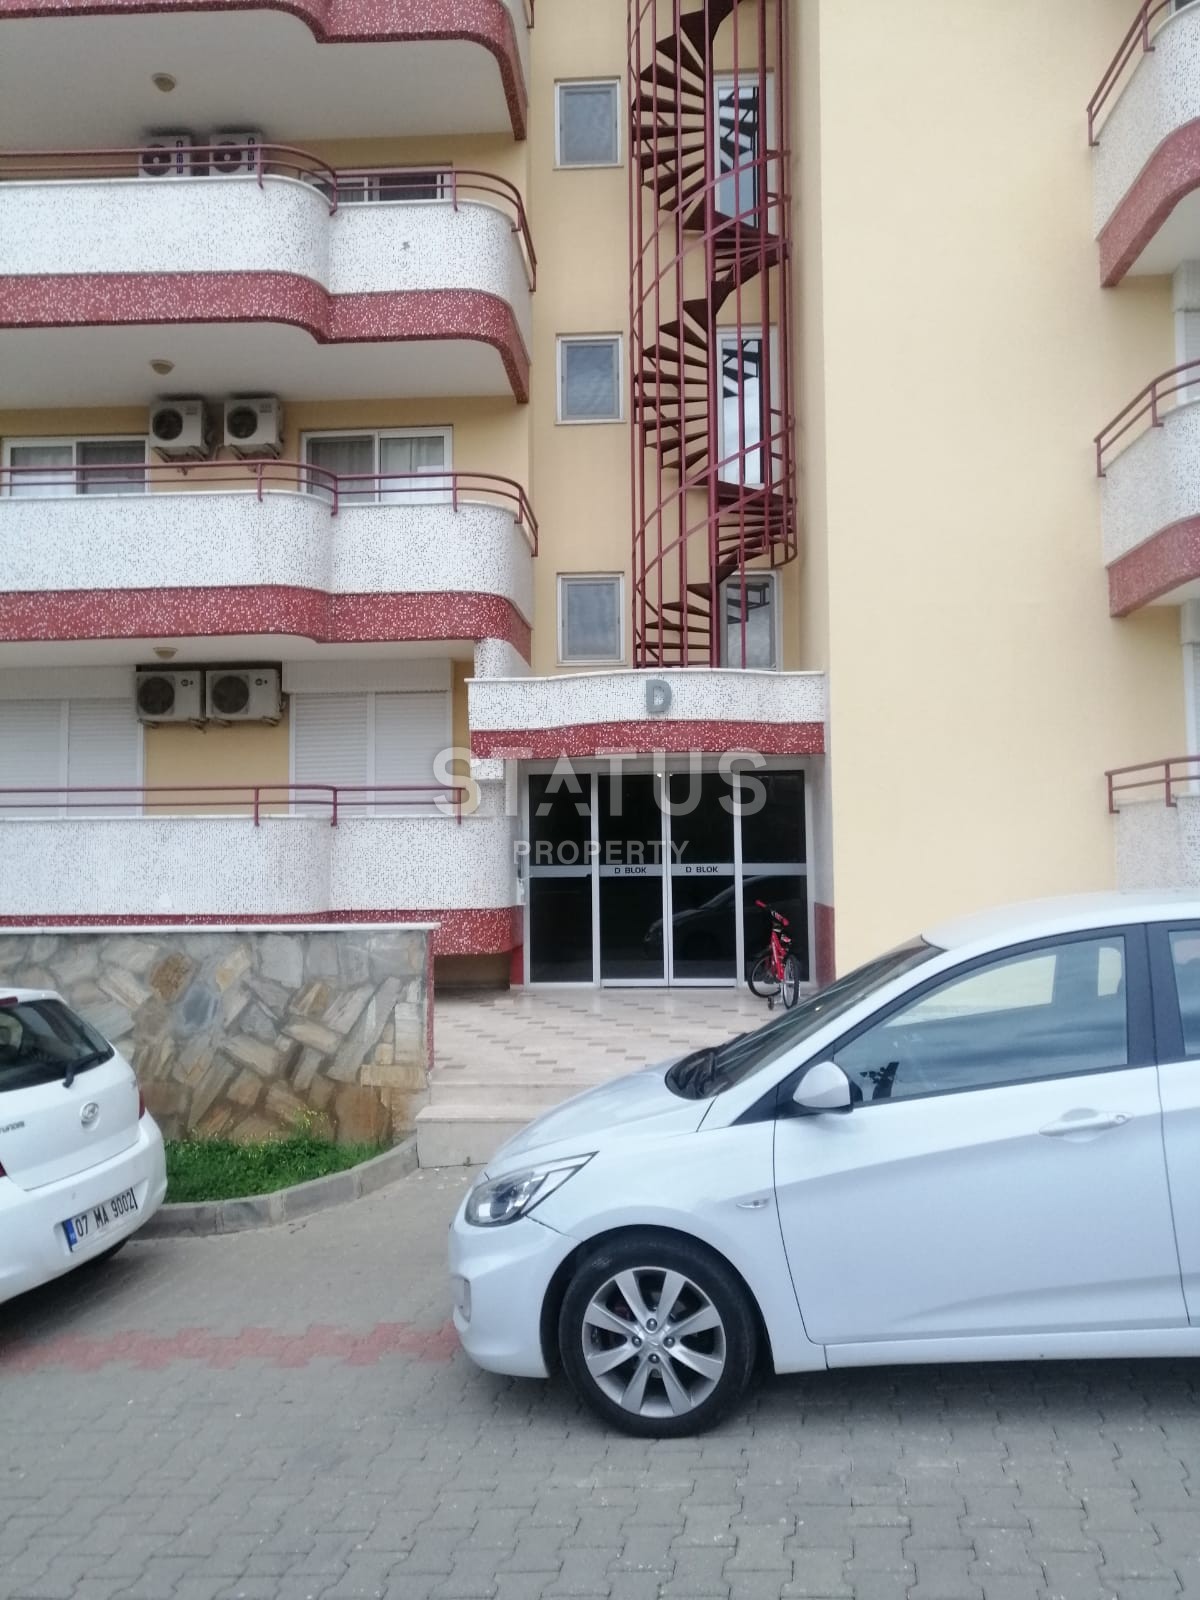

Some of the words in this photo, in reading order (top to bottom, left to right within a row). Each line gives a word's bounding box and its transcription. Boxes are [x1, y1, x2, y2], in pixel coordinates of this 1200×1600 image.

[645, 679, 672, 713] D
[624, 866, 647, 874] BLOK
[75, 1214, 88, 1237] 07
[93, 1206, 109, 1228] MA
